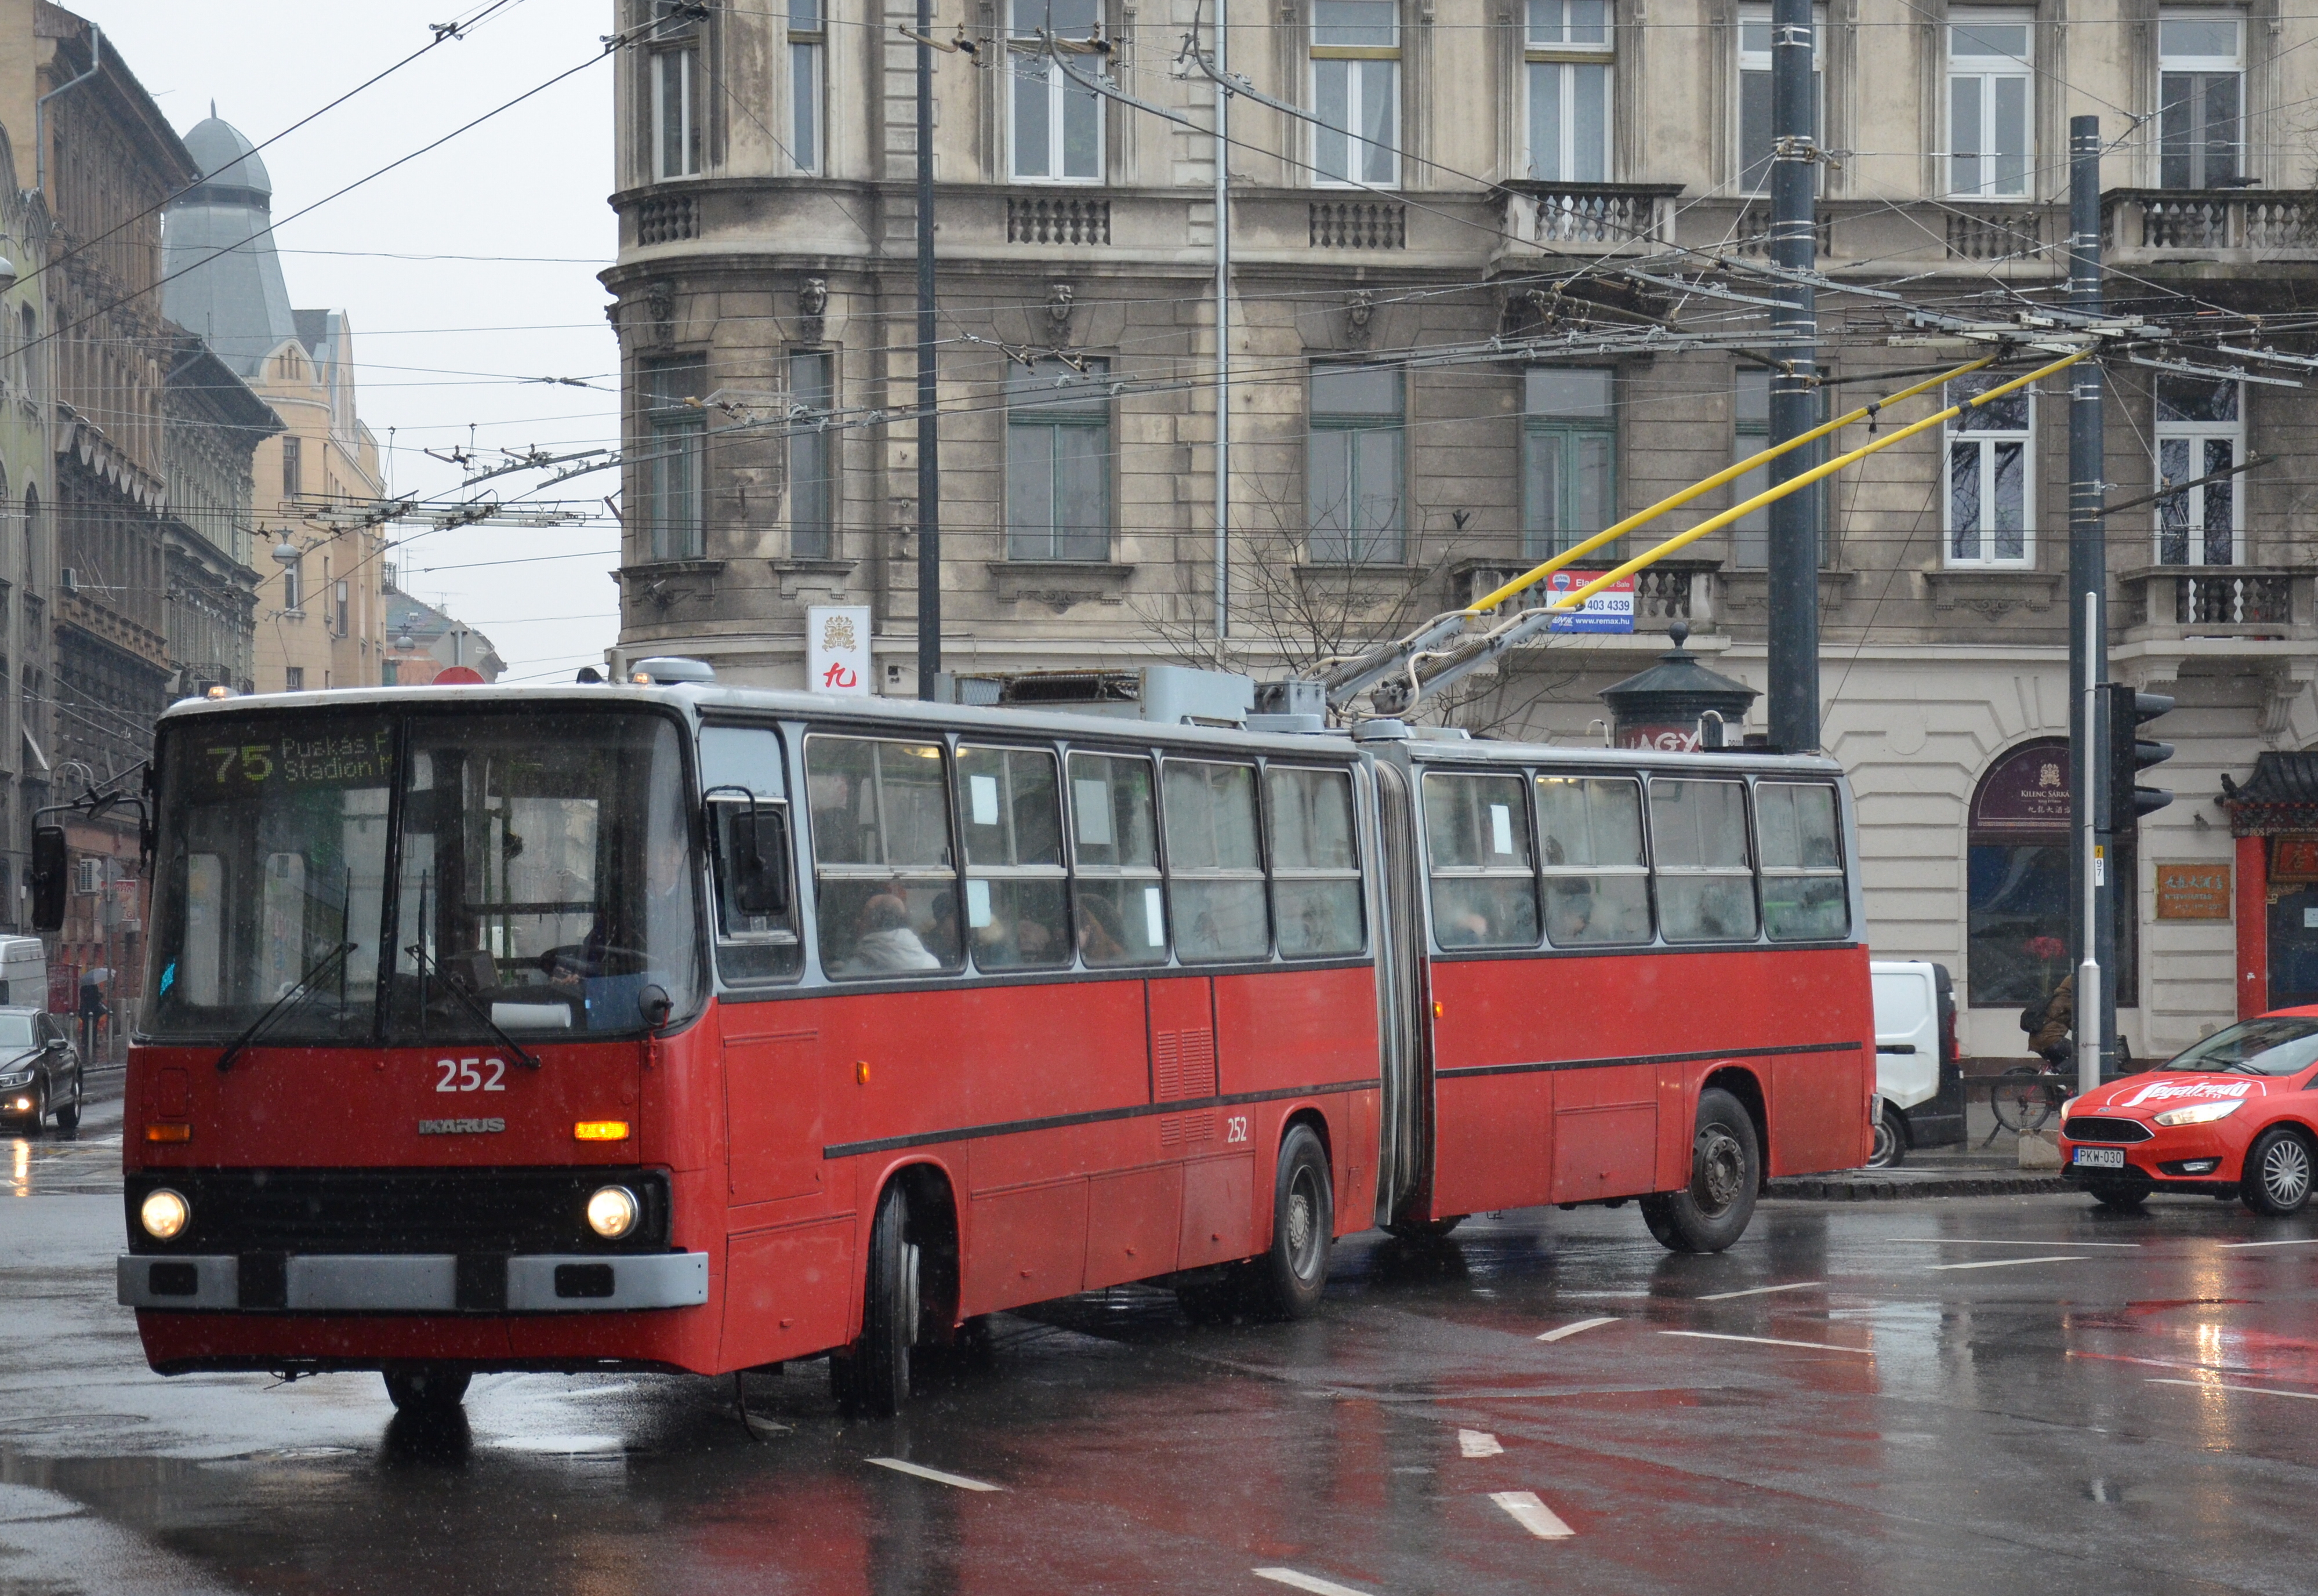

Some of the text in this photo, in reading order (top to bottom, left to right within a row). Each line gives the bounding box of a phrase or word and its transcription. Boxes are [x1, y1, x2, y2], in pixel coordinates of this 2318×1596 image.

[1587, 600, 1630, 611] 403 4339
[823, 662, 857, 688] 九
[207, 745, 273, 783] 75
[284, 757, 372, 781] Stadion
[436, 1058, 506, 1092] 252
[2121, 1081, 2252, 1107] Segafredo
[419, 1117, 506, 1134] IKARUS
[1228, 1116, 1247, 1143] 252
[2080, 1149, 2121, 1163] PKW-030
